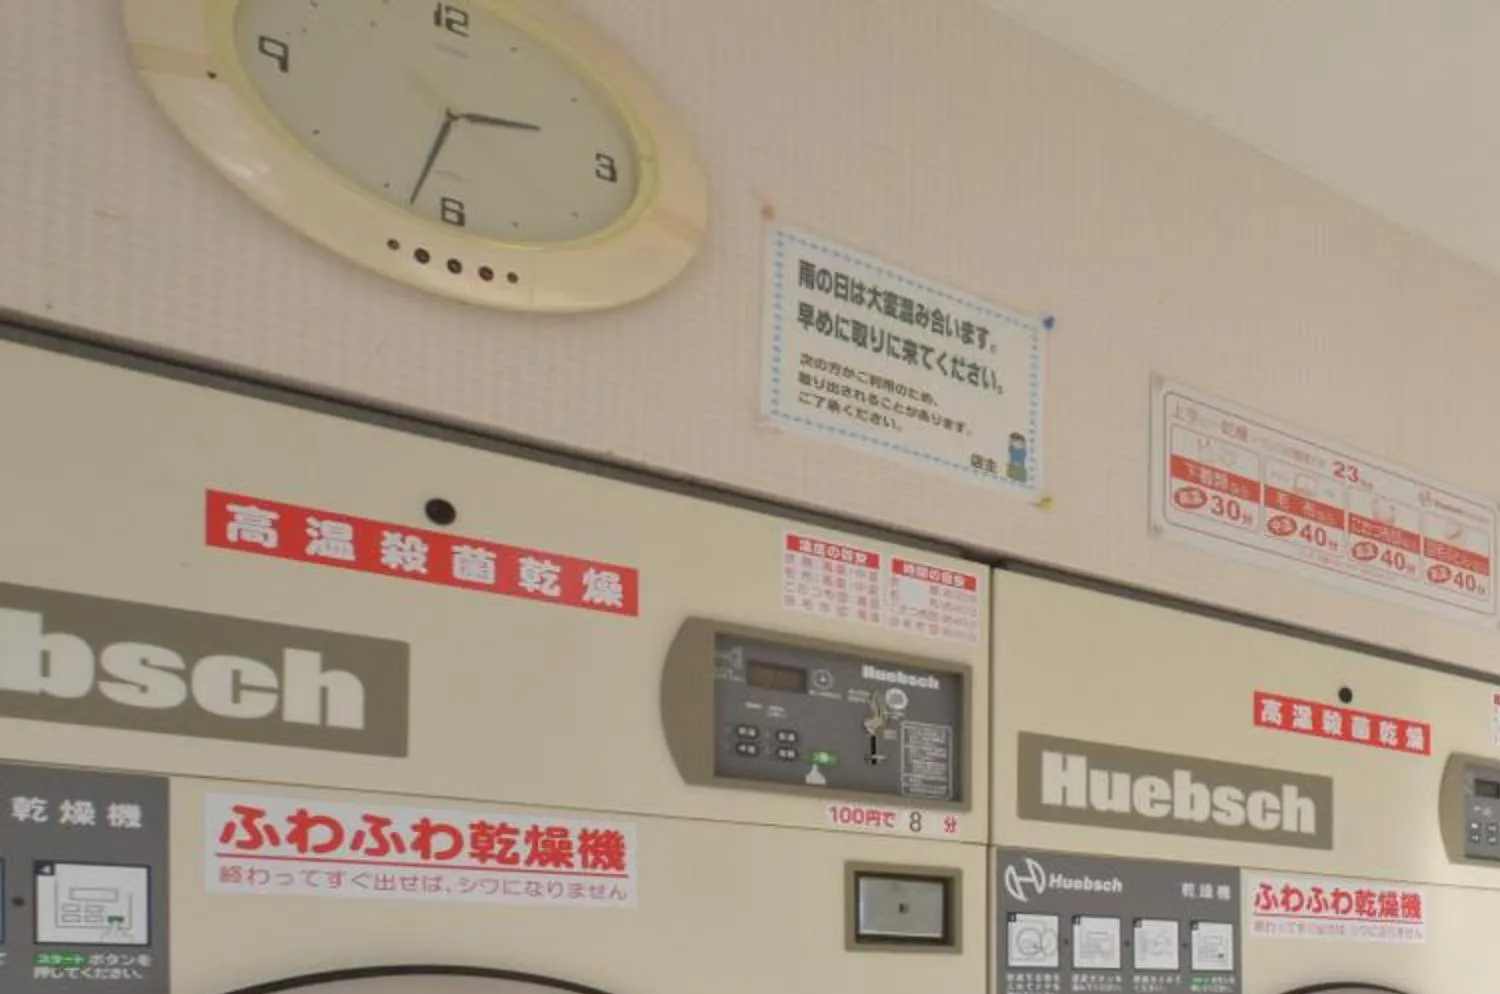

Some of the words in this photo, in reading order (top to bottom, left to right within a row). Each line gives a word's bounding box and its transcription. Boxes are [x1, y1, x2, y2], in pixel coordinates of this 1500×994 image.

[595, 152, 618, 183] 3
[441, 196, 466, 227] 6
[226, 502, 625, 608] 高温殺菌乾燥
[11, 796, 142, 829] 乾燥機
[1040, 749, 1317, 835] Huebsch
[219, 804, 630, 873] ふわふわ乾燥機
